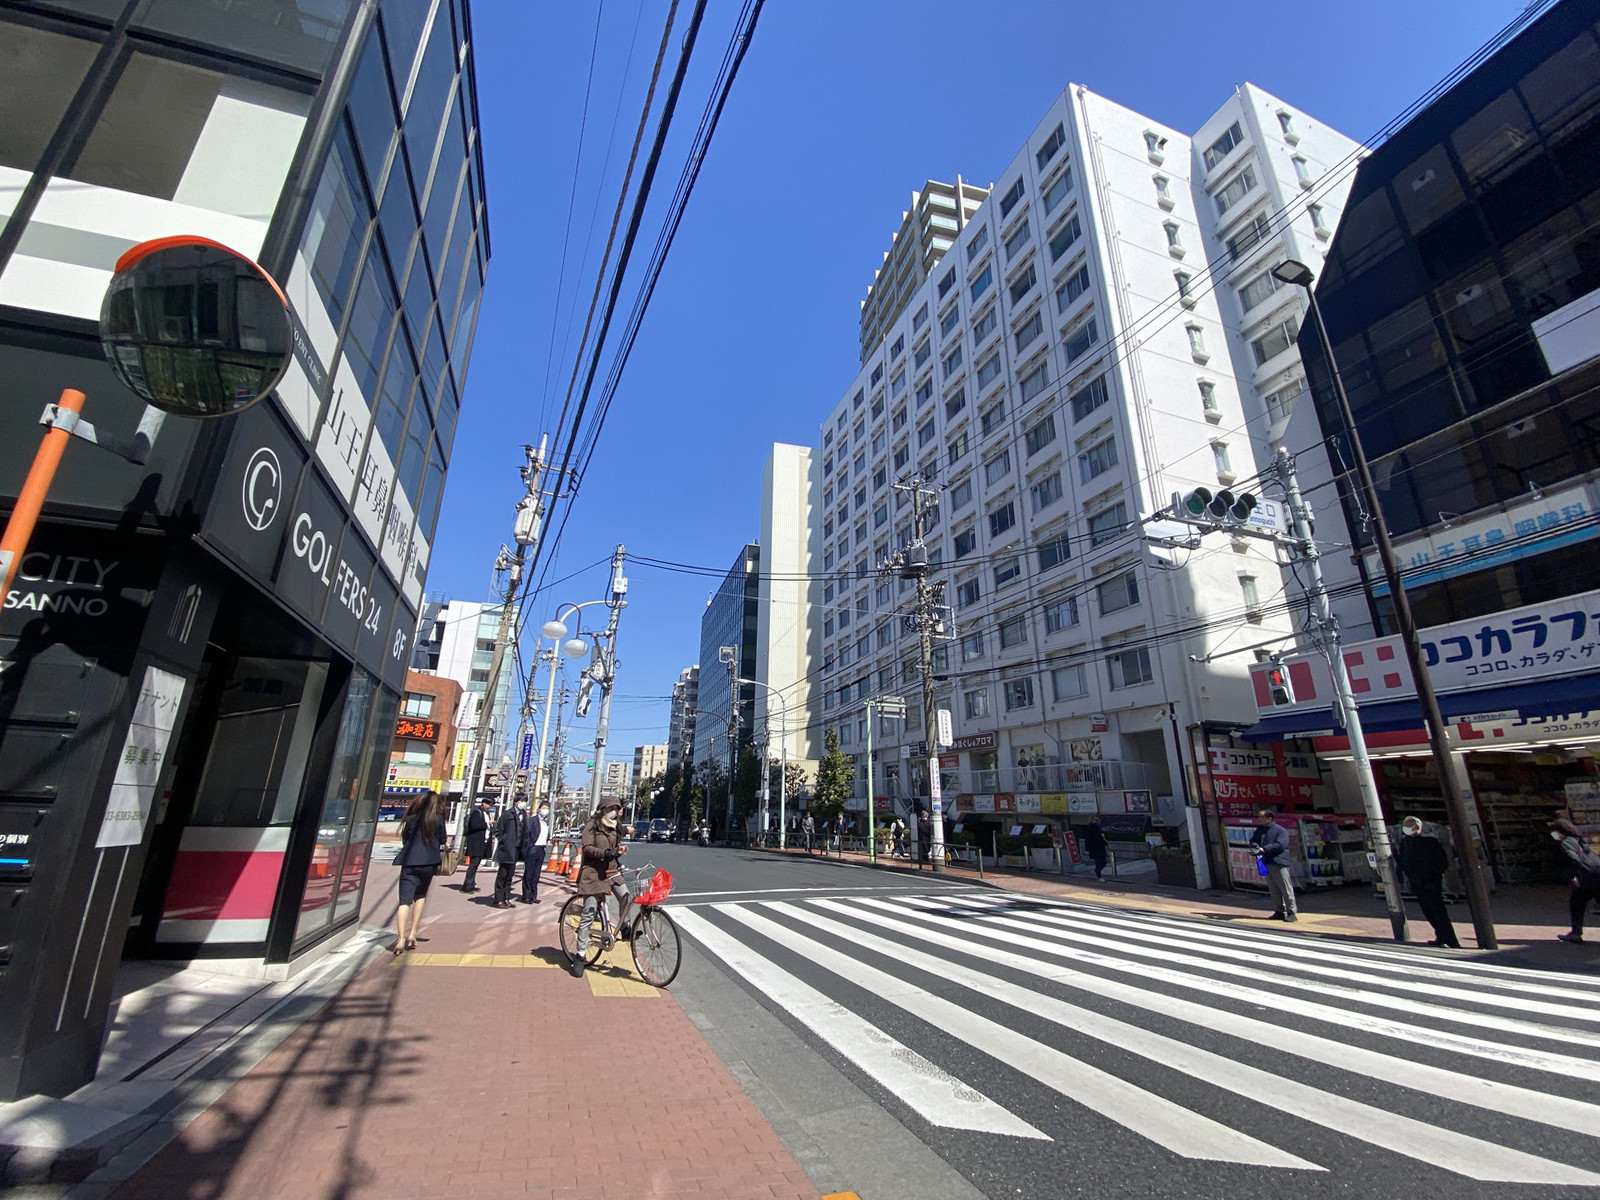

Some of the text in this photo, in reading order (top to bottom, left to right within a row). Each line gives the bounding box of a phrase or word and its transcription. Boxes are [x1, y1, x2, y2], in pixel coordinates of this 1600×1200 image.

[20, 552, 120, 588] CITY
[293, 512, 406, 660] GOLFERS 24 8F
[4, 590, 108, 616] SANNO
[1420, 610, 1600, 667] ココカラフ
[141, 688, 178, 712] テナント
[124, 745, 162, 768] 募集中
[1213, 778, 1254, 798] 処方せん
